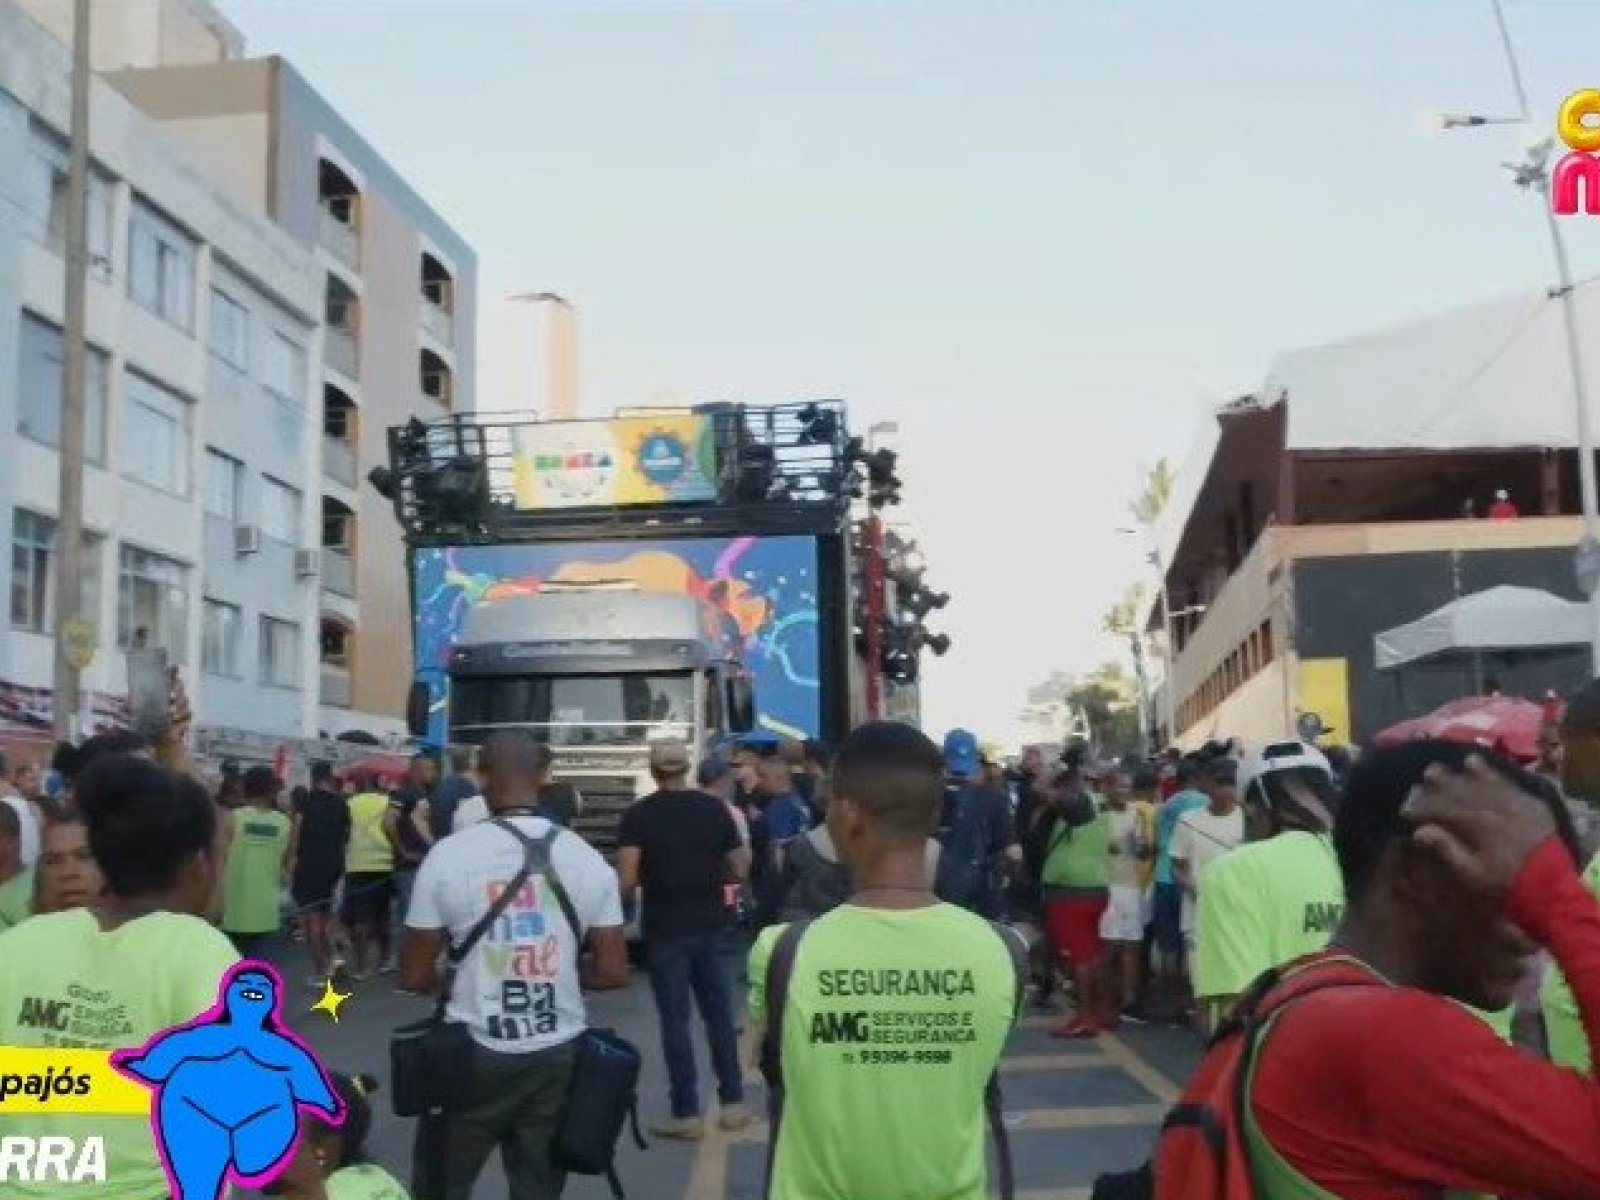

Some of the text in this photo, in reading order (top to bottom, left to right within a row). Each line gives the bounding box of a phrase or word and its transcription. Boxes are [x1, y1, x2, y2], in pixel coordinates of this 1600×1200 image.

[1303, 901, 1345, 933] AM
[818, 969, 976, 1001] SEGURANÇA
[17, 997, 71, 1031] AMG
[810, 1011, 868, 1044] AMG
